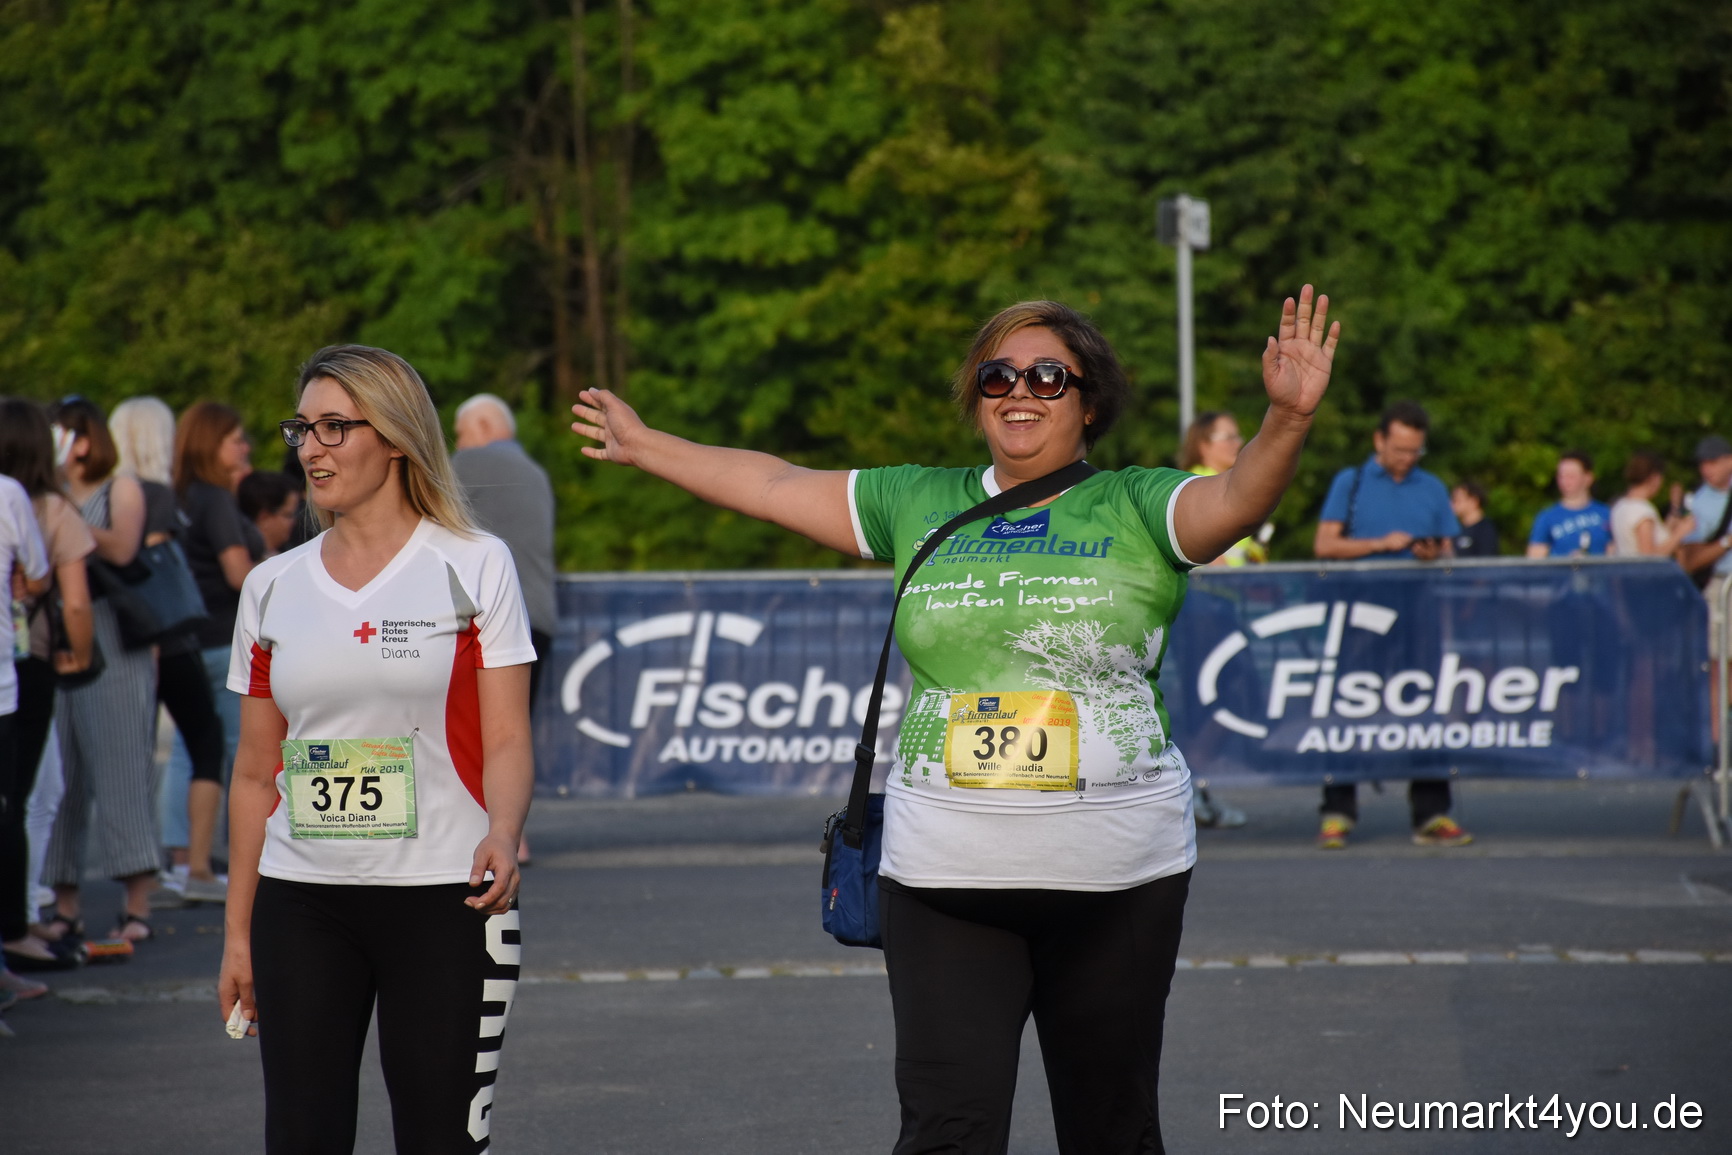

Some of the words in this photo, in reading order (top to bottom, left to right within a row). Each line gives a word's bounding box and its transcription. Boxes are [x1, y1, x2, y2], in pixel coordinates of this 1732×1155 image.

[923, 511, 939, 524] 10
[950, 534, 1114, 558] firmenlauf
[943, 553, 1011, 564] neumarkt
[999, 571, 1098, 588] Firmen
[925, 592, 1004, 611] laufen
[1018, 589, 1114, 613] länger!
[381, 620, 436, 628] Bayerisches
[381, 647, 420, 659] Diana
[1266, 652, 1580, 719] Fischer
[629, 666, 902, 729] Fische
[967, 709, 1018, 719] firmenlauf
[1047, 717, 1071, 726] 2019
[1297, 720, 1554, 753] AUTOMOBILE
[973, 726, 1048, 761] 380
[301, 759, 349, 769] firmenlauf
[360, 765, 376, 774] run
[380, 765, 404, 774] 2019
[978, 762, 1002, 770] Wille
[310, 776, 383, 812] 375
[320, 814, 346, 823] Voica
[348, 813, 376, 822] Diana
